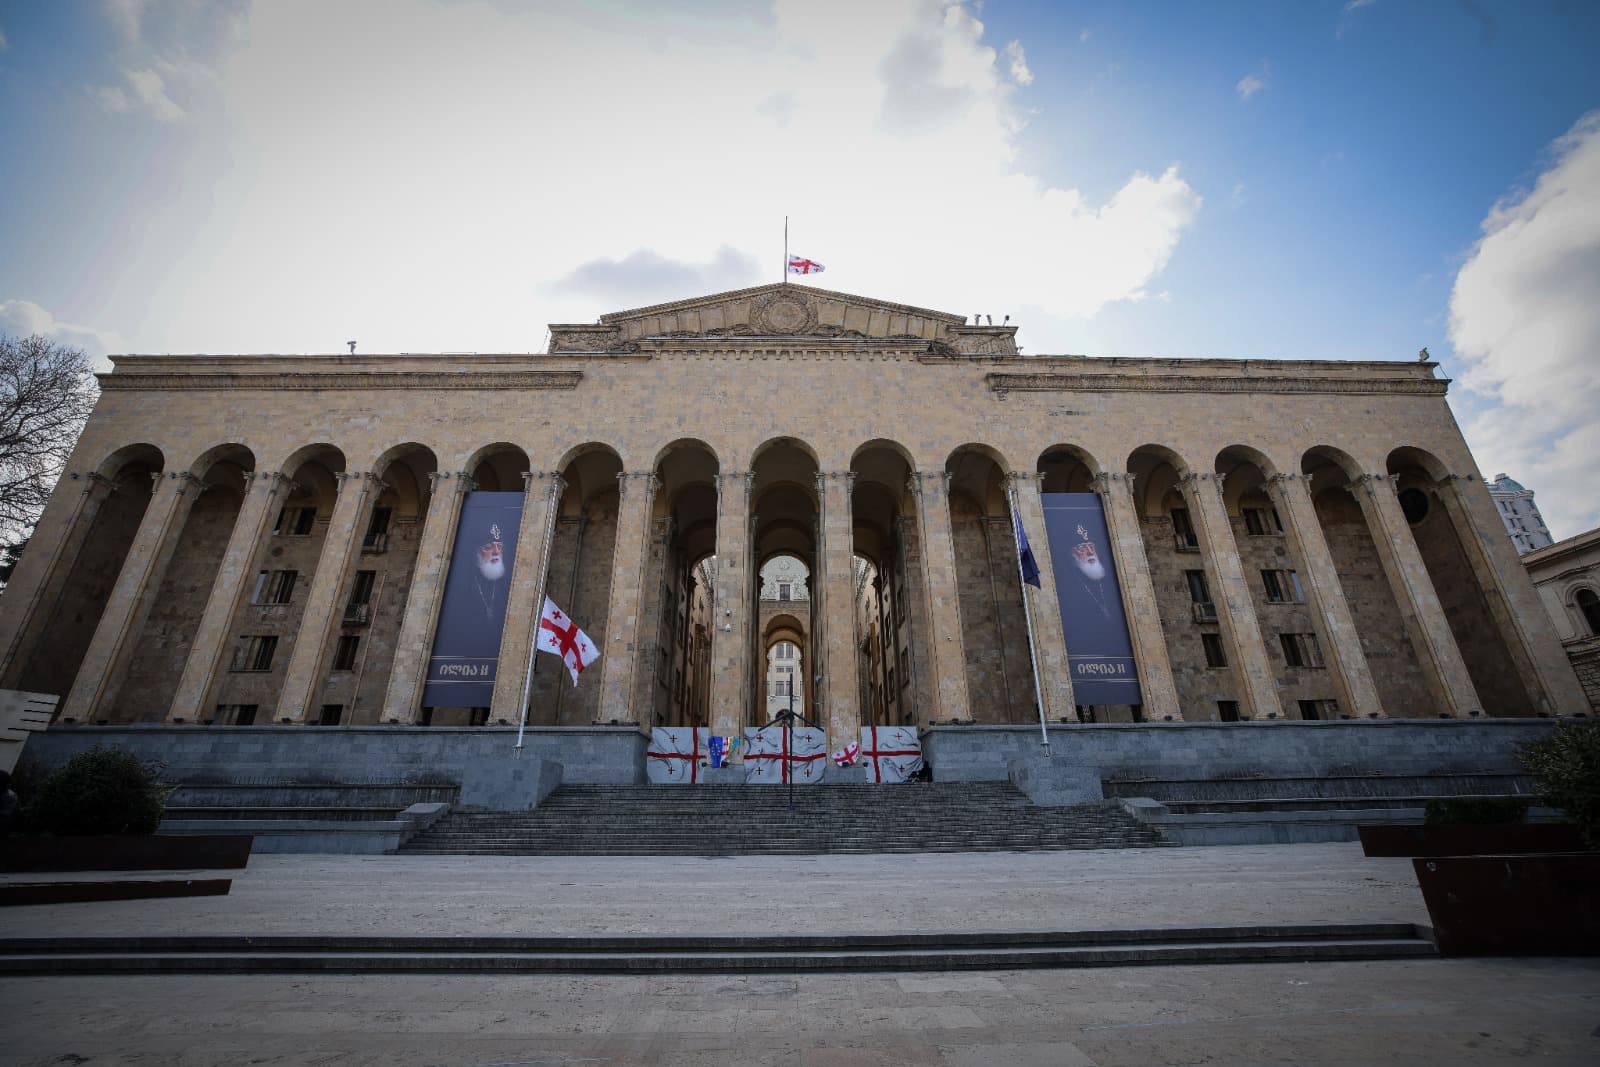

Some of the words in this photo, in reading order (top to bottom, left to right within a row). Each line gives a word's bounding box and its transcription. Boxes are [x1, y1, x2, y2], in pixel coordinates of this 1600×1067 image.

[439, 664, 478, 676] ილია
[480, 664, 489, 676] II
[1077, 663, 1115, 675] ილია
